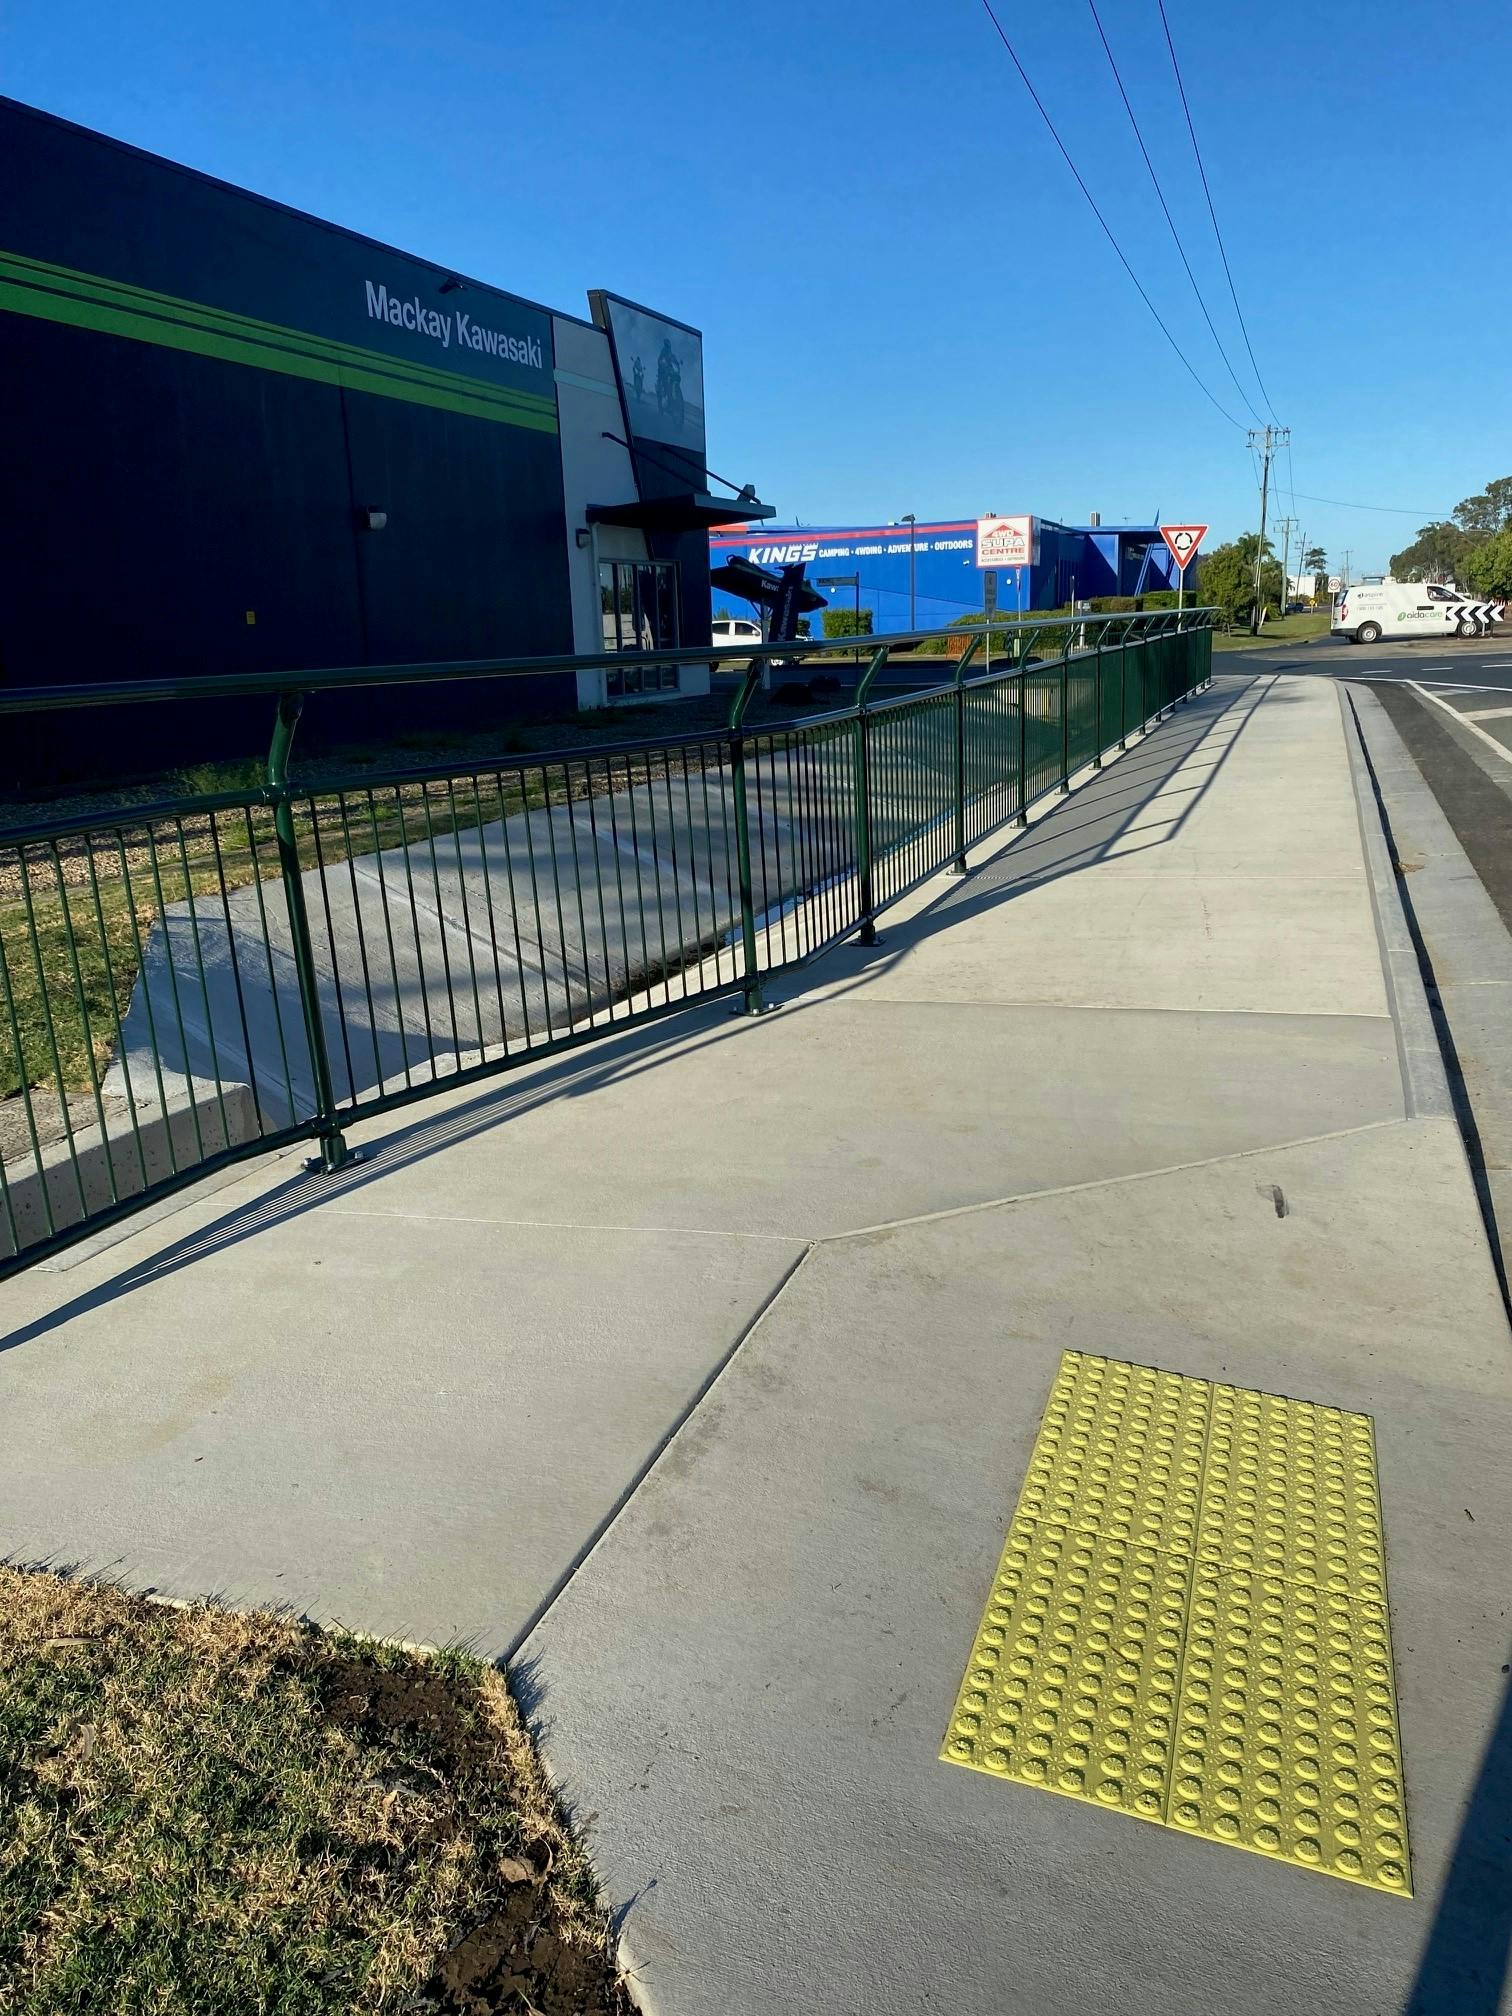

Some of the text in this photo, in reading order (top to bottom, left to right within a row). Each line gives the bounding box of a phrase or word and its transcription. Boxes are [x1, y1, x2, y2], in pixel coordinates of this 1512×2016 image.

[365, 280, 543, 369] Mackay Kawasaki
[981, 537, 1026, 548] SUPA
[748, 542, 819, 564] KINGS
[819, 547, 850, 558] CAMPING
[855, 545, 883, 556] 4WDING
[934, 539, 973, 551] OUTDOORS
[981, 547, 1025, 555] CENTRE
[1406, 611, 1443, 619] aidacare
